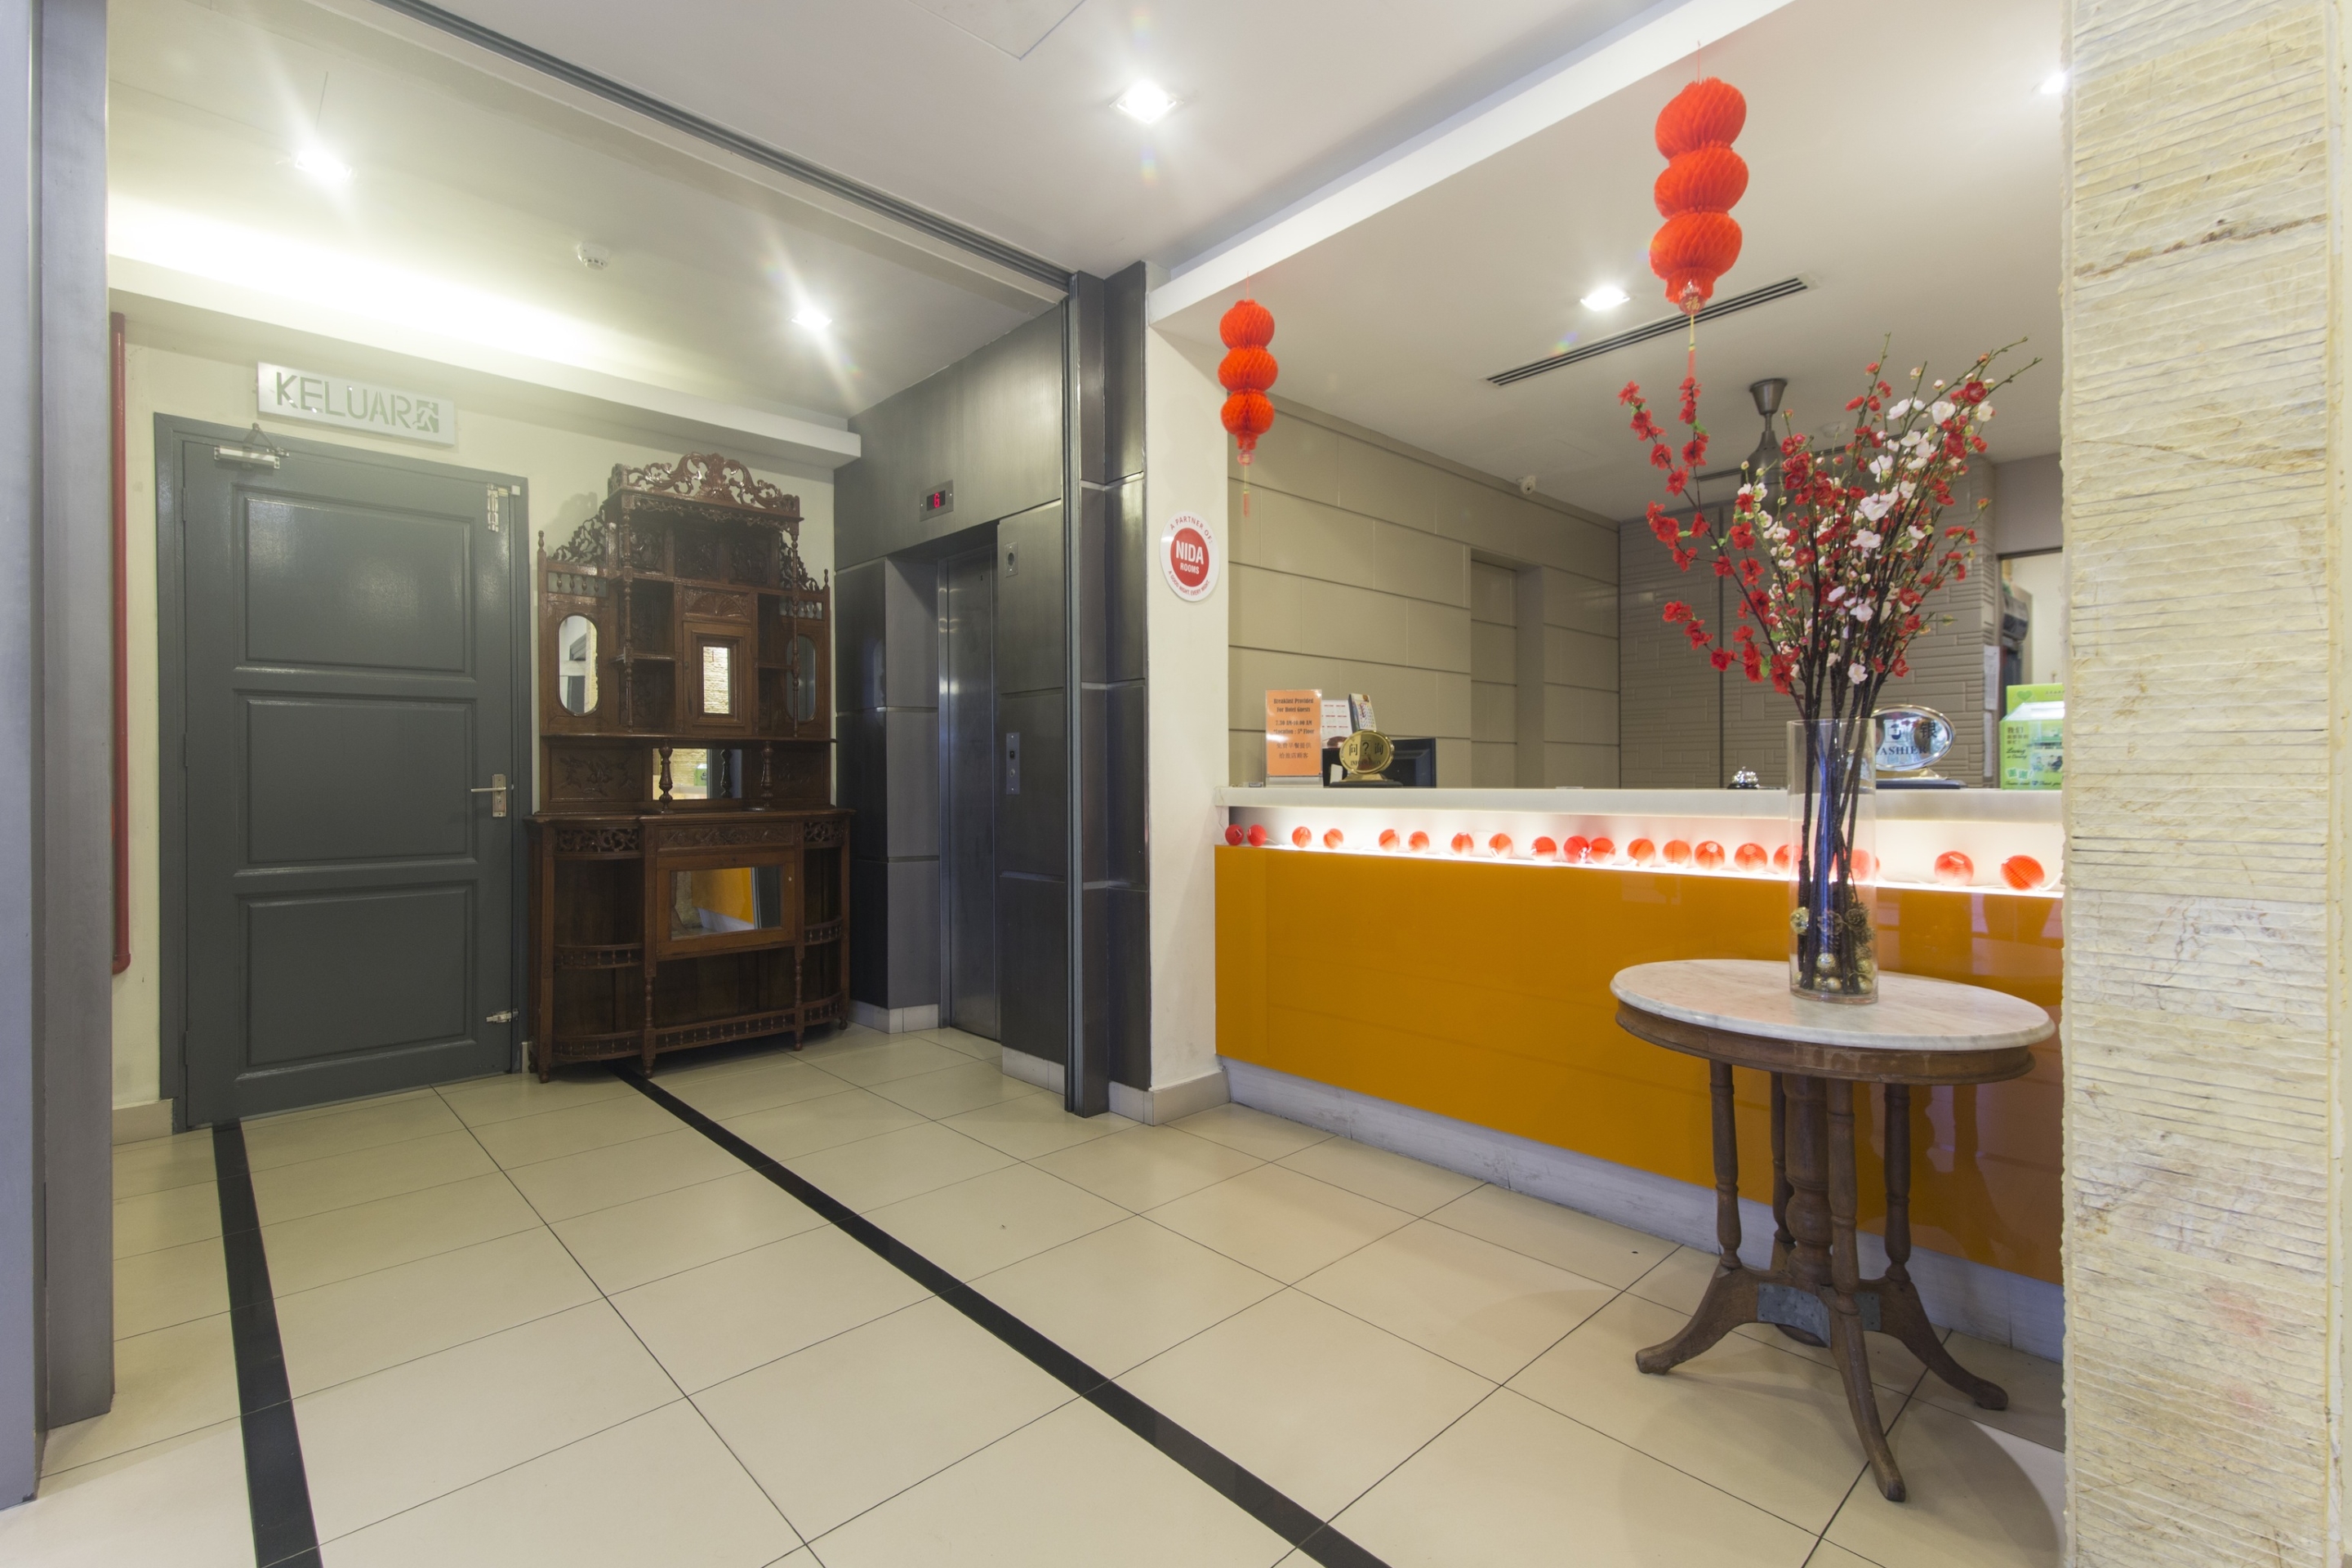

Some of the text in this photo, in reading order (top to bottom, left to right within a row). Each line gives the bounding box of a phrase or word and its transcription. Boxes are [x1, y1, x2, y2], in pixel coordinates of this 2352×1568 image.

[276, 372, 412, 429] KELUAR
[1175, 515, 1204, 530] PARTNER
[1176, 540, 1204, 565] NIDA
[1180, 562, 1200, 575] ROOMS
